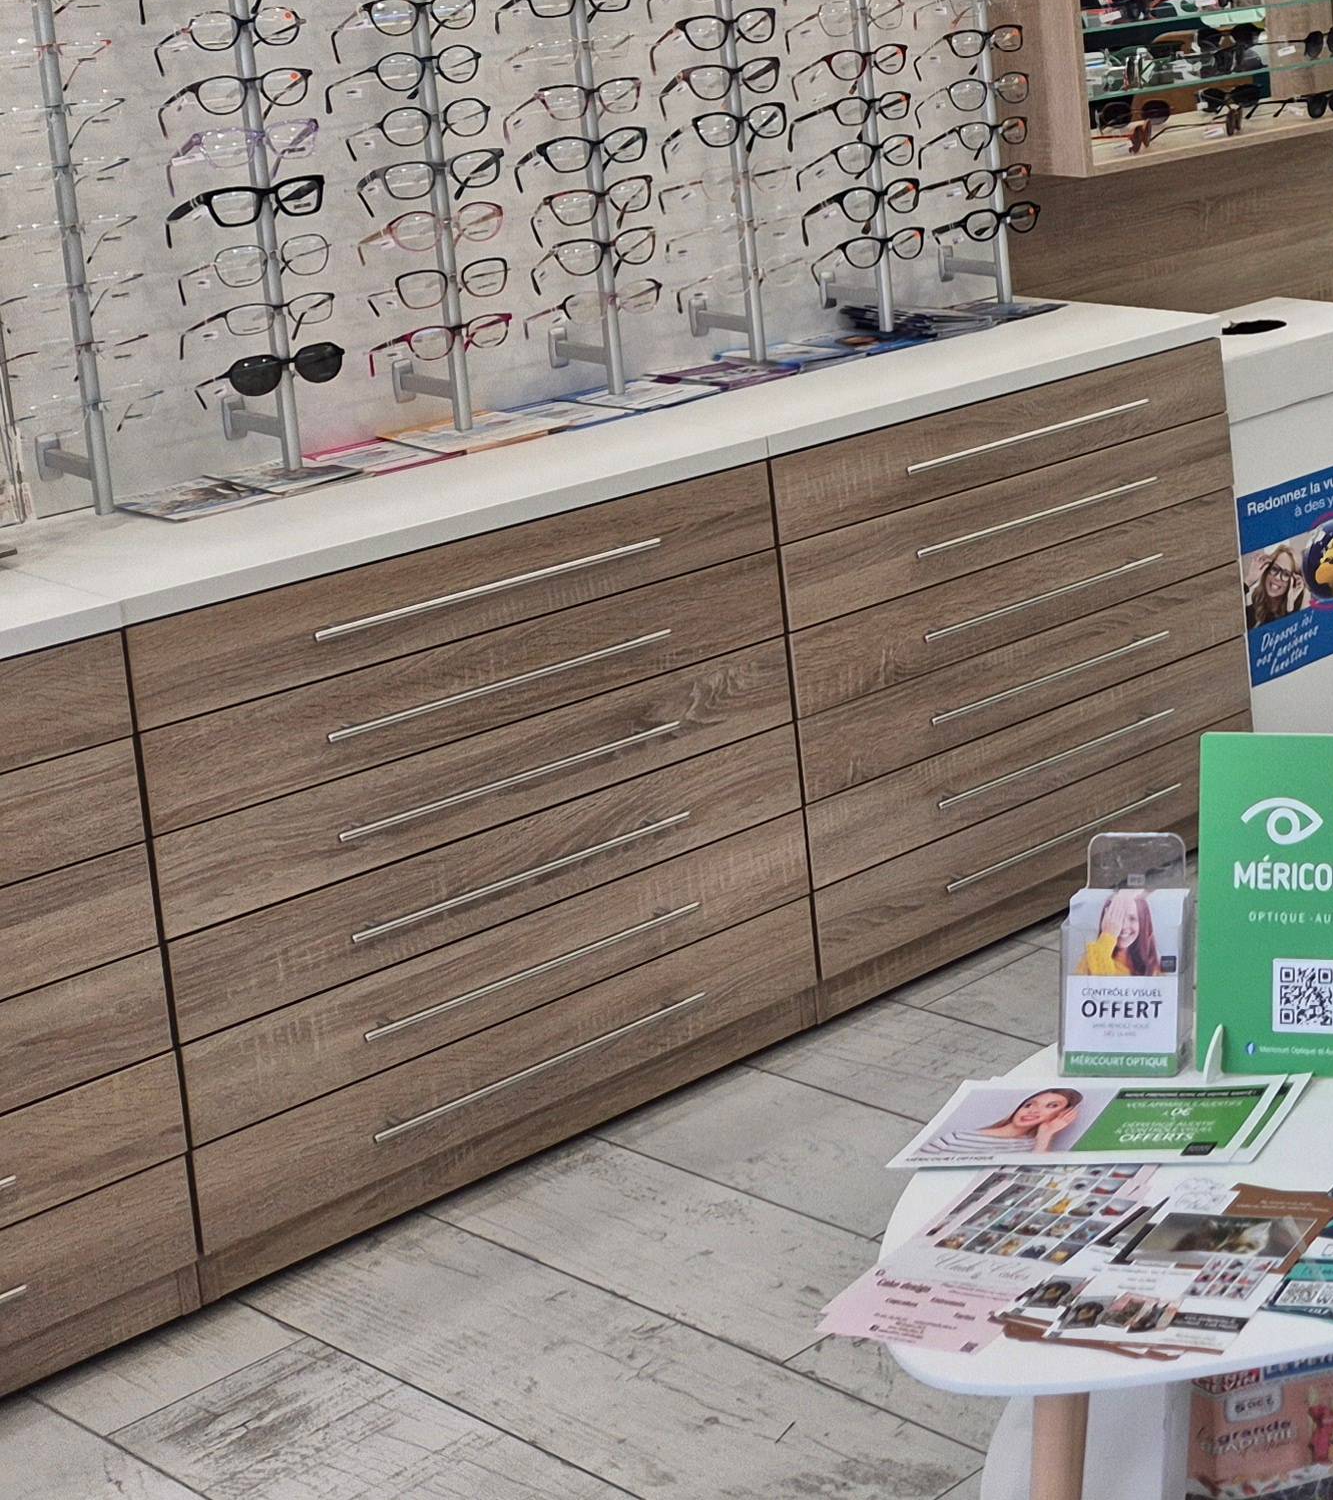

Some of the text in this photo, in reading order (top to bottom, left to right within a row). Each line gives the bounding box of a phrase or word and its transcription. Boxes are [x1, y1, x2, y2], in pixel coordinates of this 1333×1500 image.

[1247, 487, 1308, 516] Redonnez
[1310, 483, 1322, 495] la
[1294, 505, 1303, 517] à
[1304, 499, 1326, 514] des
[1261, 621, 1299, 653] Déposez
[1248, 910, 1305, 925] OPTIQUE
[1081, 988, 1162, 997] CONTRÔLE VISUEL
[1081, 999, 1163, 1018] OFFERT
[1070, 1054, 1169, 1068] MÉRICOURT OPTIQUE
